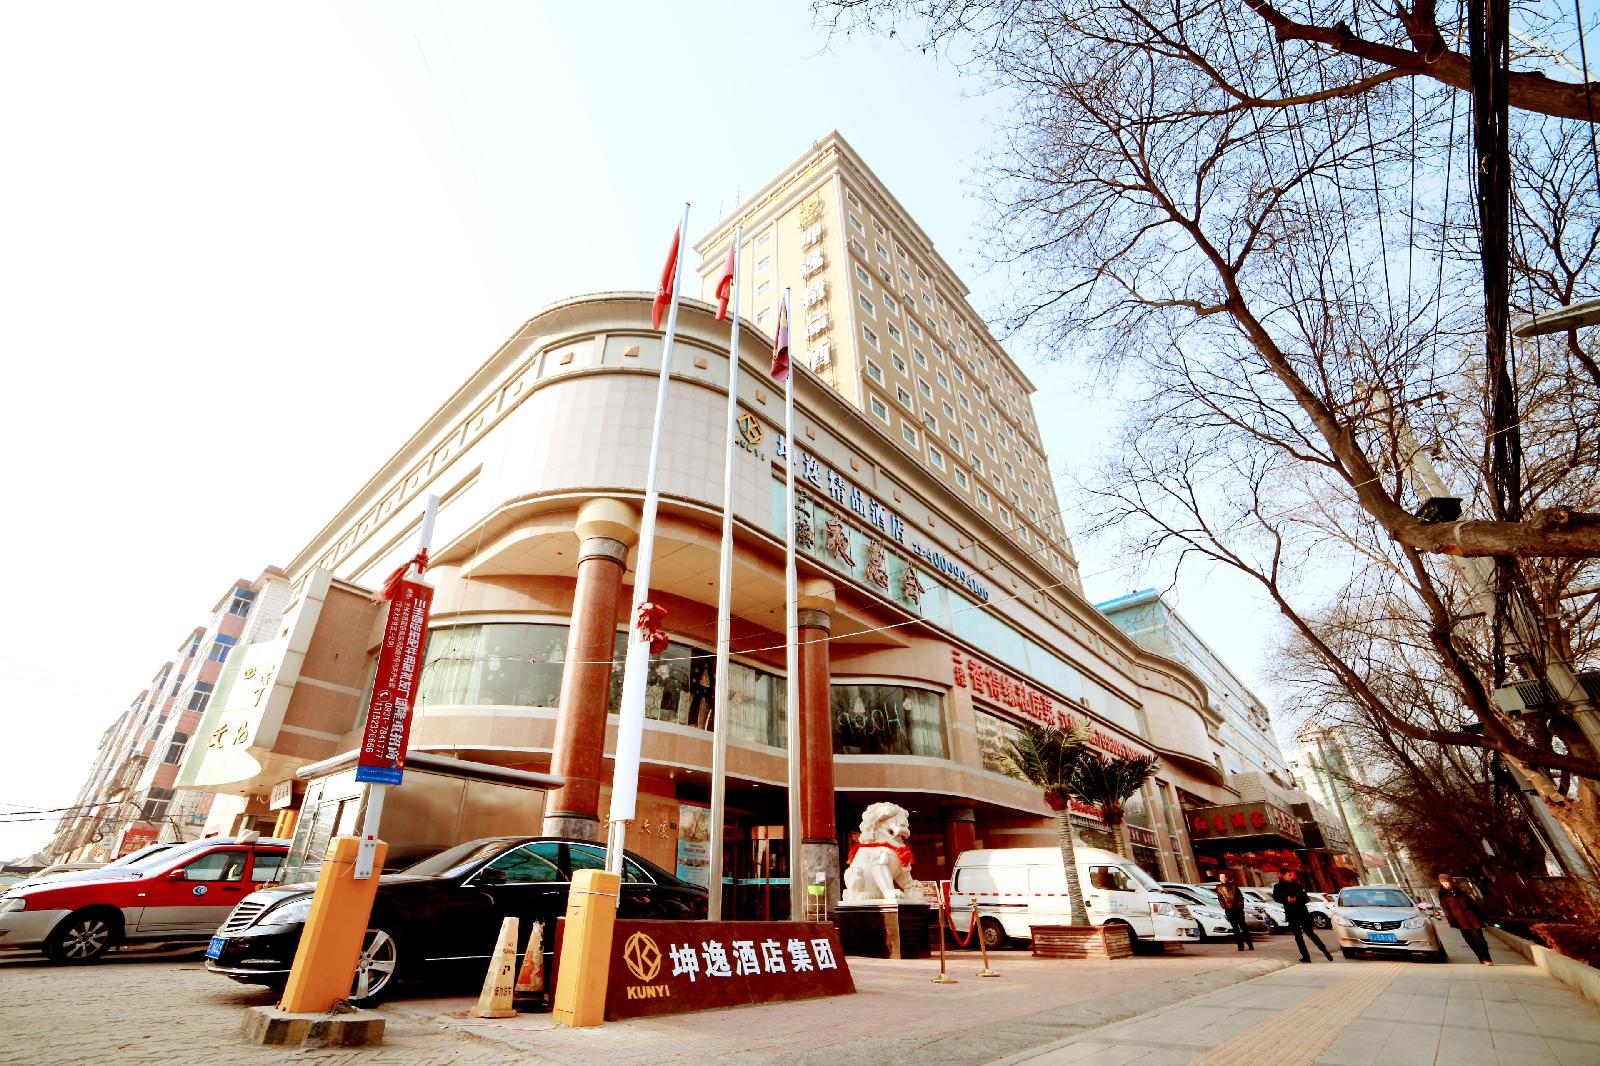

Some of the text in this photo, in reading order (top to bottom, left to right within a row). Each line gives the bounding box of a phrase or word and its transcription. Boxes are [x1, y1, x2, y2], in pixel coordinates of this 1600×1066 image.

[669, 938, 838, 982] 坤逸酒店集团
[626, 985, 670, 999] KUNYI
